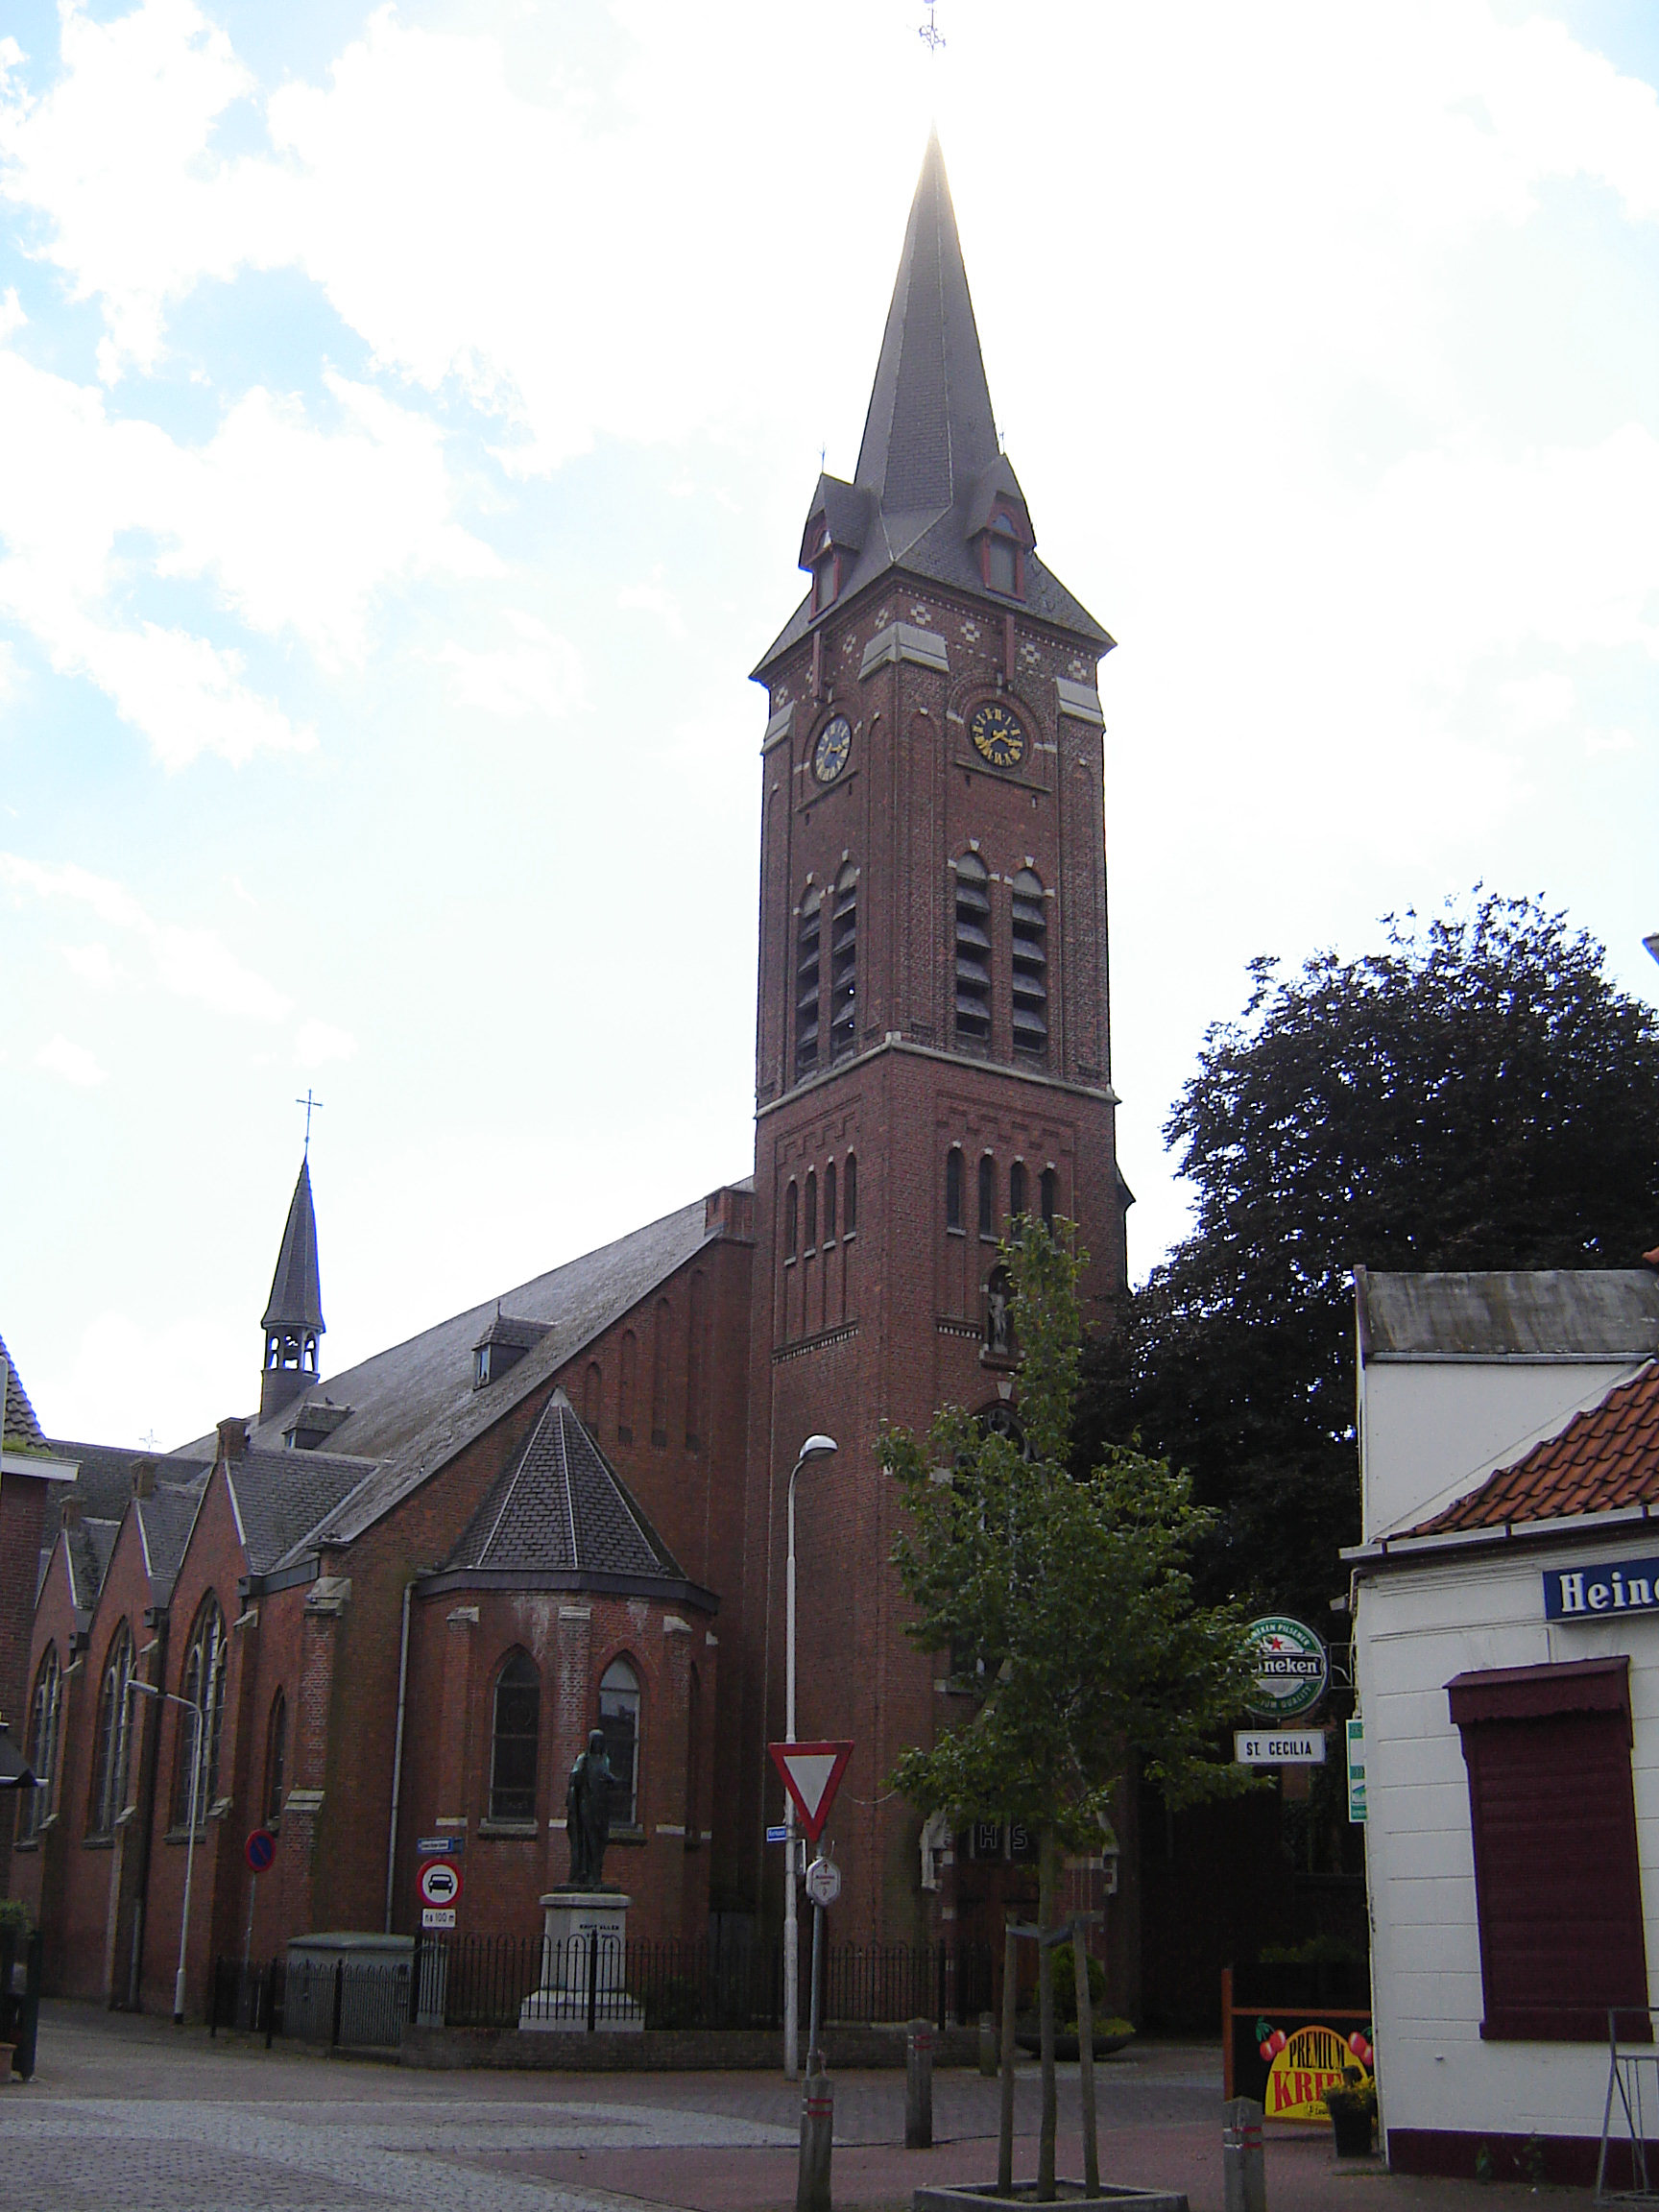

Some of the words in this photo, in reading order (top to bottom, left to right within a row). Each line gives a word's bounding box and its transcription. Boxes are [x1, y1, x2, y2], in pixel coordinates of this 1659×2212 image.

[1559, 1572, 1659, 1613] Hein
[1252, 1658, 1318, 1673] neken
[1246, 1742, 1261, 1756] ST.
[1268, 1741, 1312, 1756] CECILIA
[1288, 2032, 1345, 2070] PREMIUM
[1272, 2071, 1343, 2113] KRI
